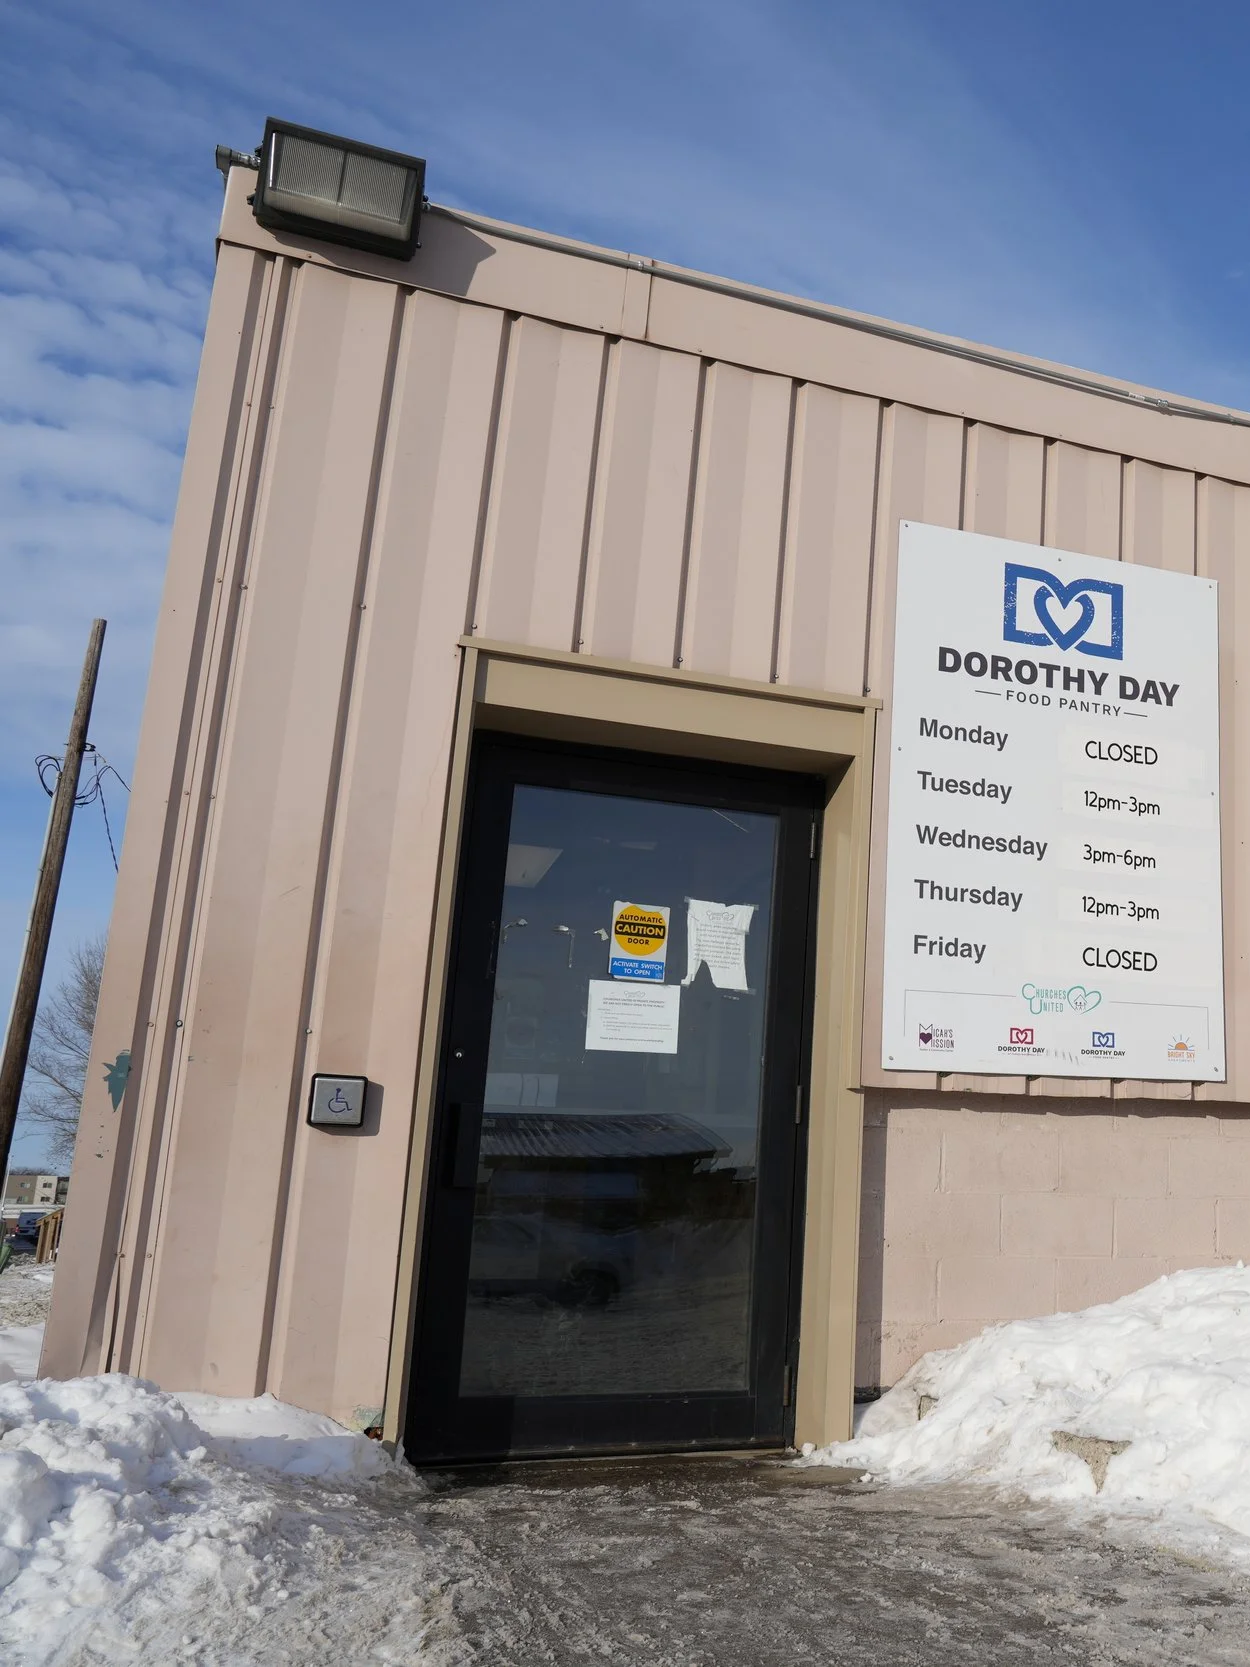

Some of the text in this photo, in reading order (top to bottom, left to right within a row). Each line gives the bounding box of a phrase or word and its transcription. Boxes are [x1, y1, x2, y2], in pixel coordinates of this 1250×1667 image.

[938, 646, 1180, 707] DOROTHY DAY
[1006, 690, 1122, 717] FOOD PANTRY
[919, 717, 1158, 765] Monday CLOSED
[916, 770, 1161, 816] Tuesday 12pm-3pm
[916, 824, 1157, 869] Wednesday 3pm-6pm
[914, 879, 1160, 921] Thursday 12pm-3pm
[615, 923, 665, 937] CAUTION
[619, 913, 663, 924] AUTOMATIC
[627, 938, 650, 946] DOOR
[913, 934, 1158, 972] Friday CLOSED
[612, 960, 663, 971] ACTIVATE SWITCH
[1022, 983, 1067, 1000] CHURCHES
[1030, 999, 1064, 1015] UNITED
